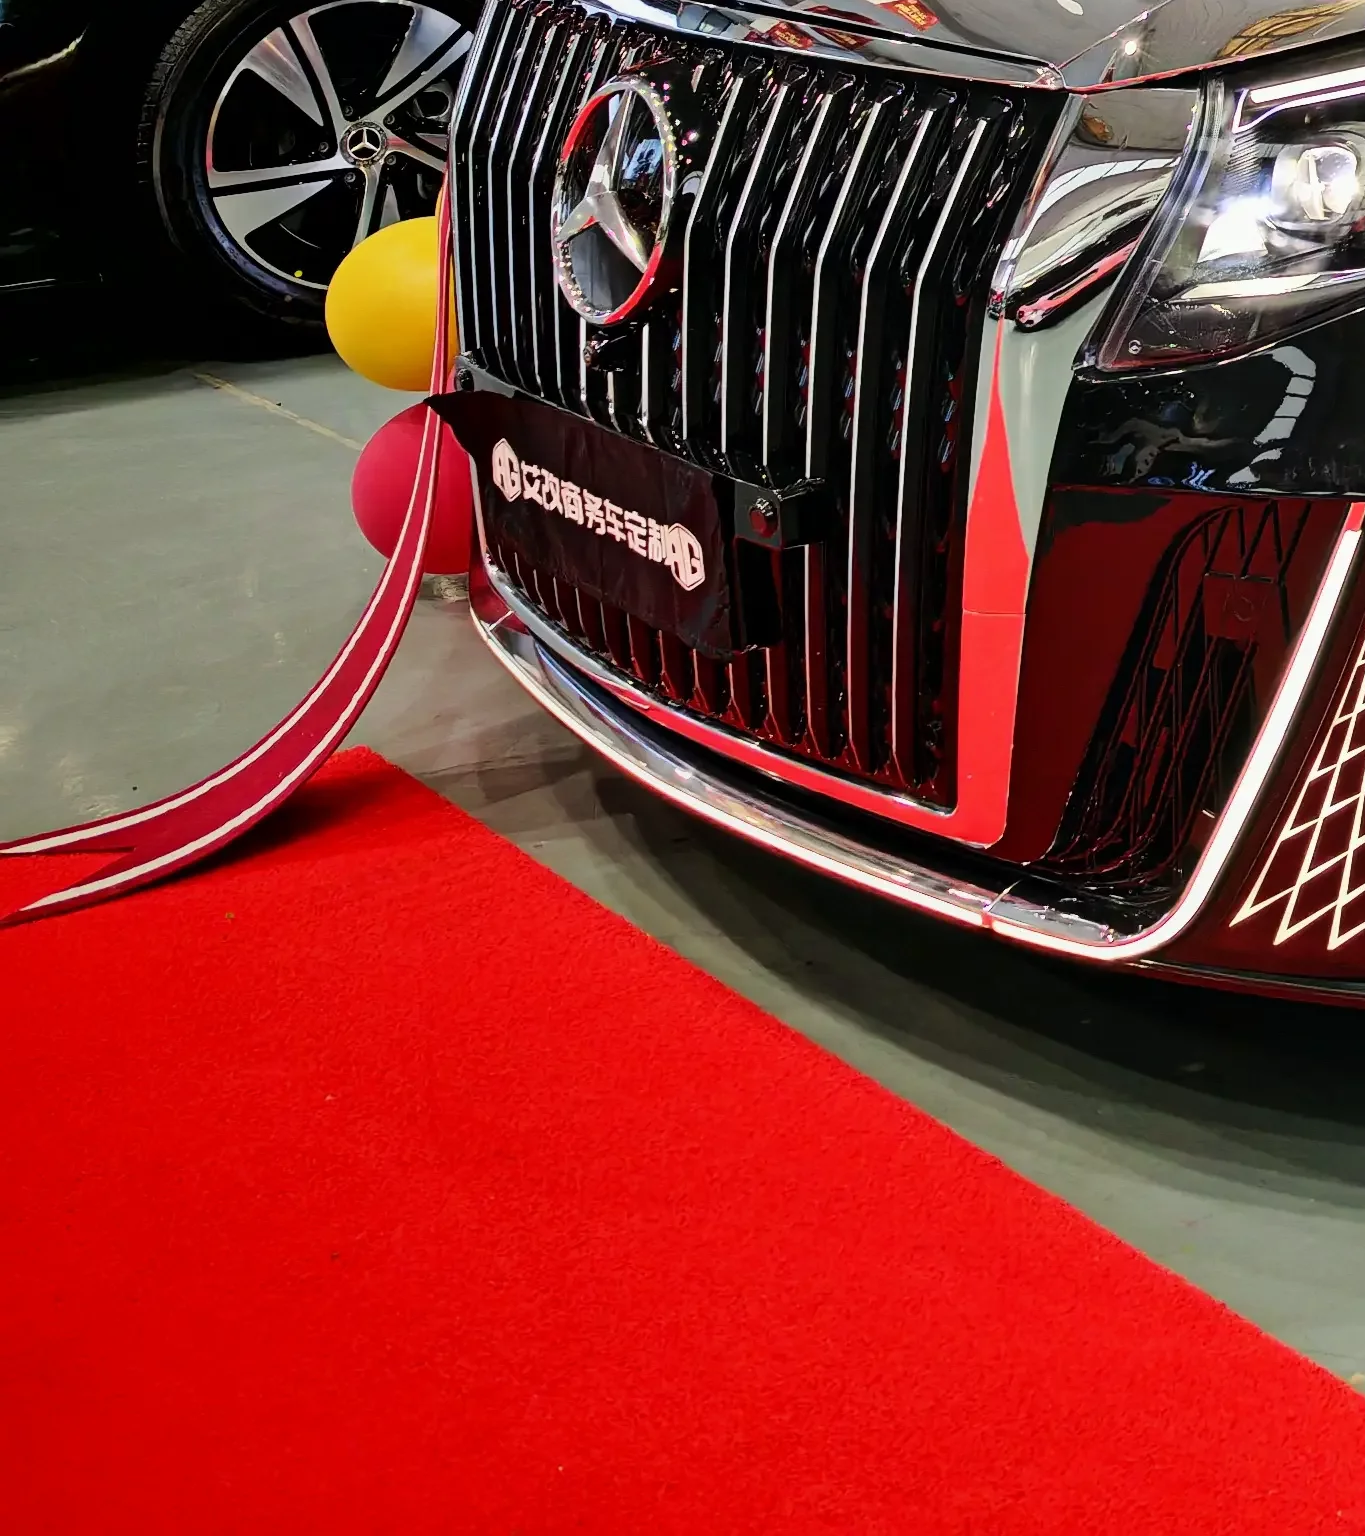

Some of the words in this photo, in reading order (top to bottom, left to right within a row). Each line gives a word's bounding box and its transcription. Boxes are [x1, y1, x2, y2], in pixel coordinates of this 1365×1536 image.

[520, 460, 668, 564] 艾改商务车定制
